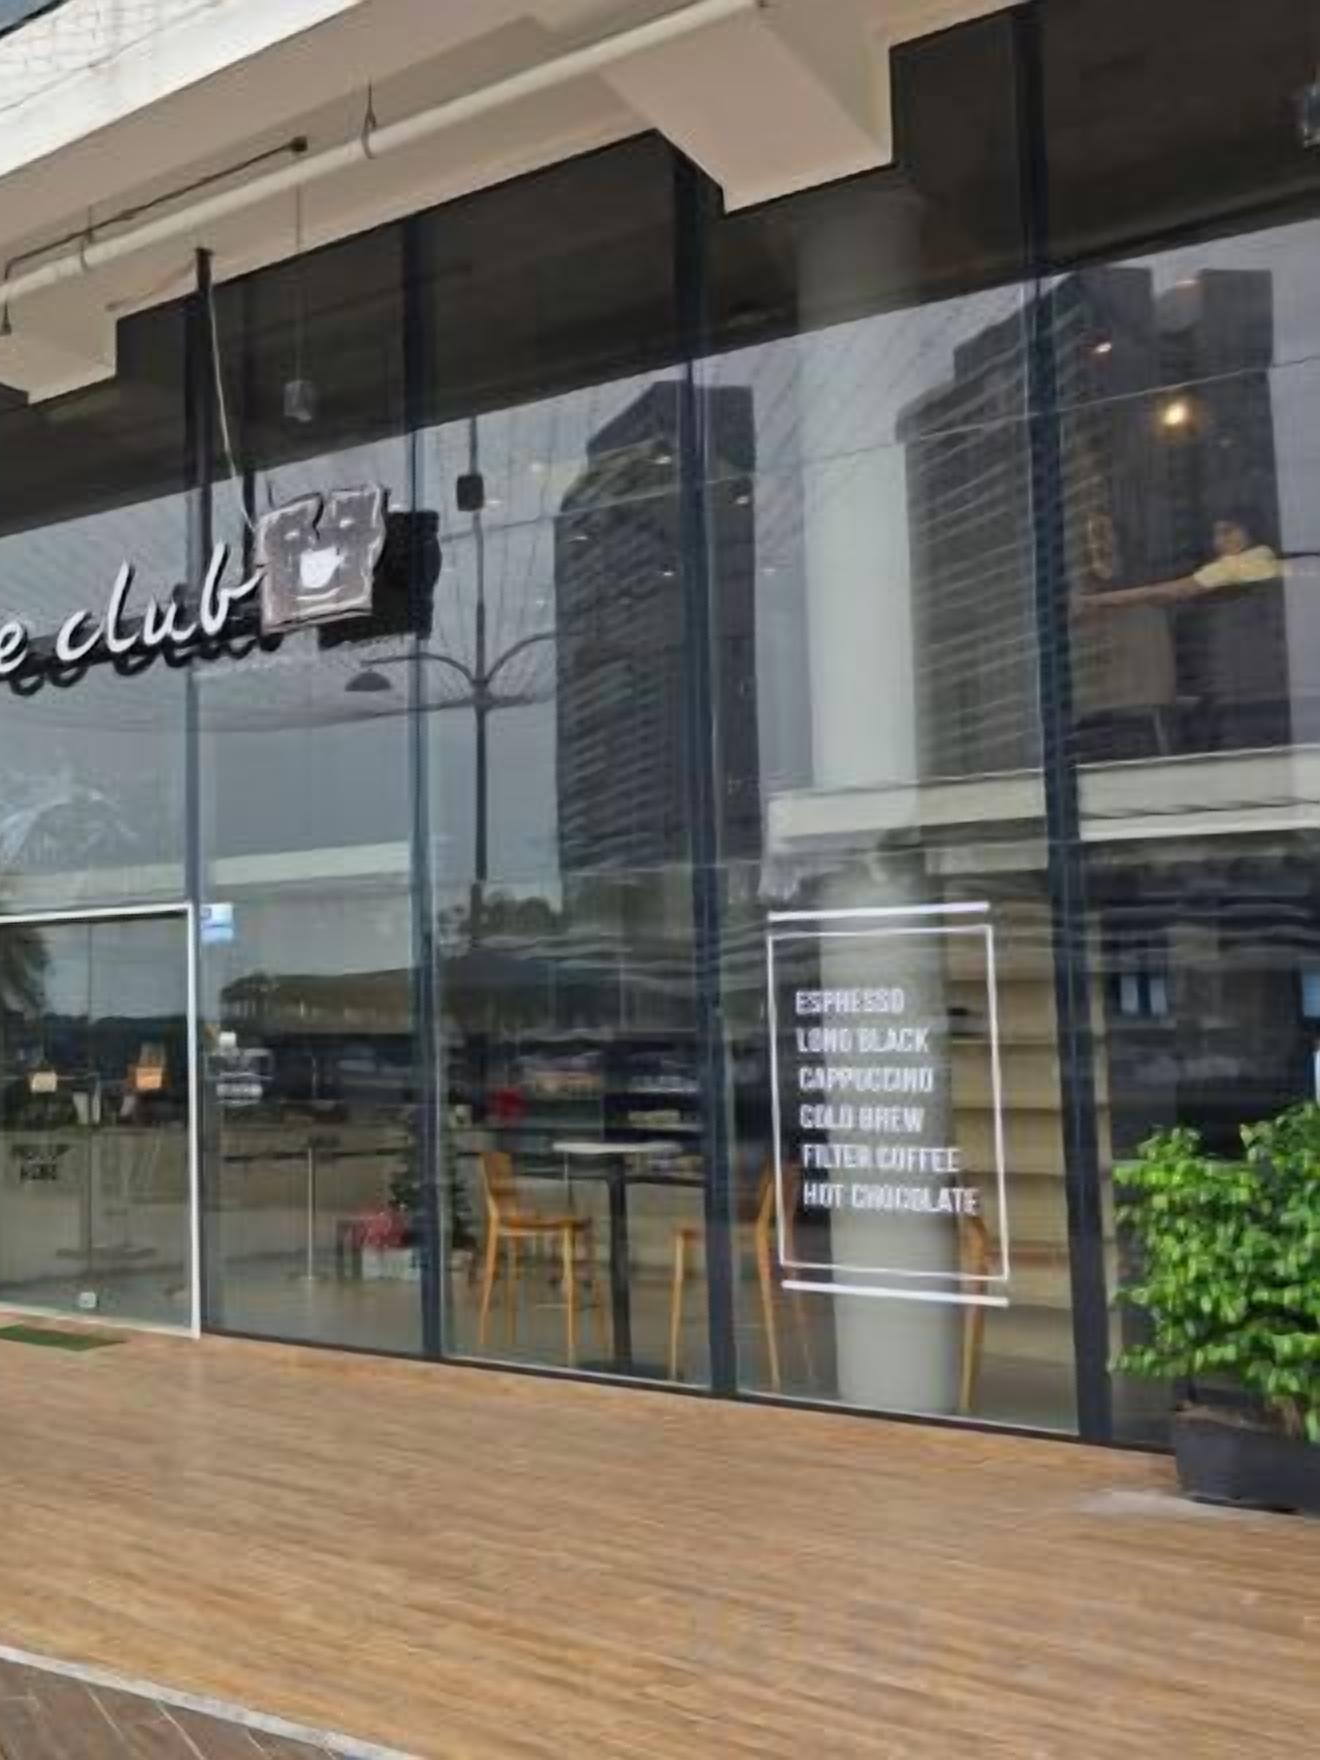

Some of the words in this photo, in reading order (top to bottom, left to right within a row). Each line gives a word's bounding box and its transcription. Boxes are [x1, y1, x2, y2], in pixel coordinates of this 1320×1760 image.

[795, 988, 905, 1014] ESPRESSO
[795, 1027, 852, 1052] LONG
[859, 1027, 930, 1052] BLACK
[799, 1066, 934, 1092] CAPPUCCINO
[800, 1103, 852, 1128] COLD
[858, 1105, 925, 1132] BREW
[803, 1143, 870, 1169] FILTER
[875, 1145, 961, 1172] COFFEE
[803, 1182, 844, 1208] HOT
[851, 1183, 980, 1214] CHOCOLATE
